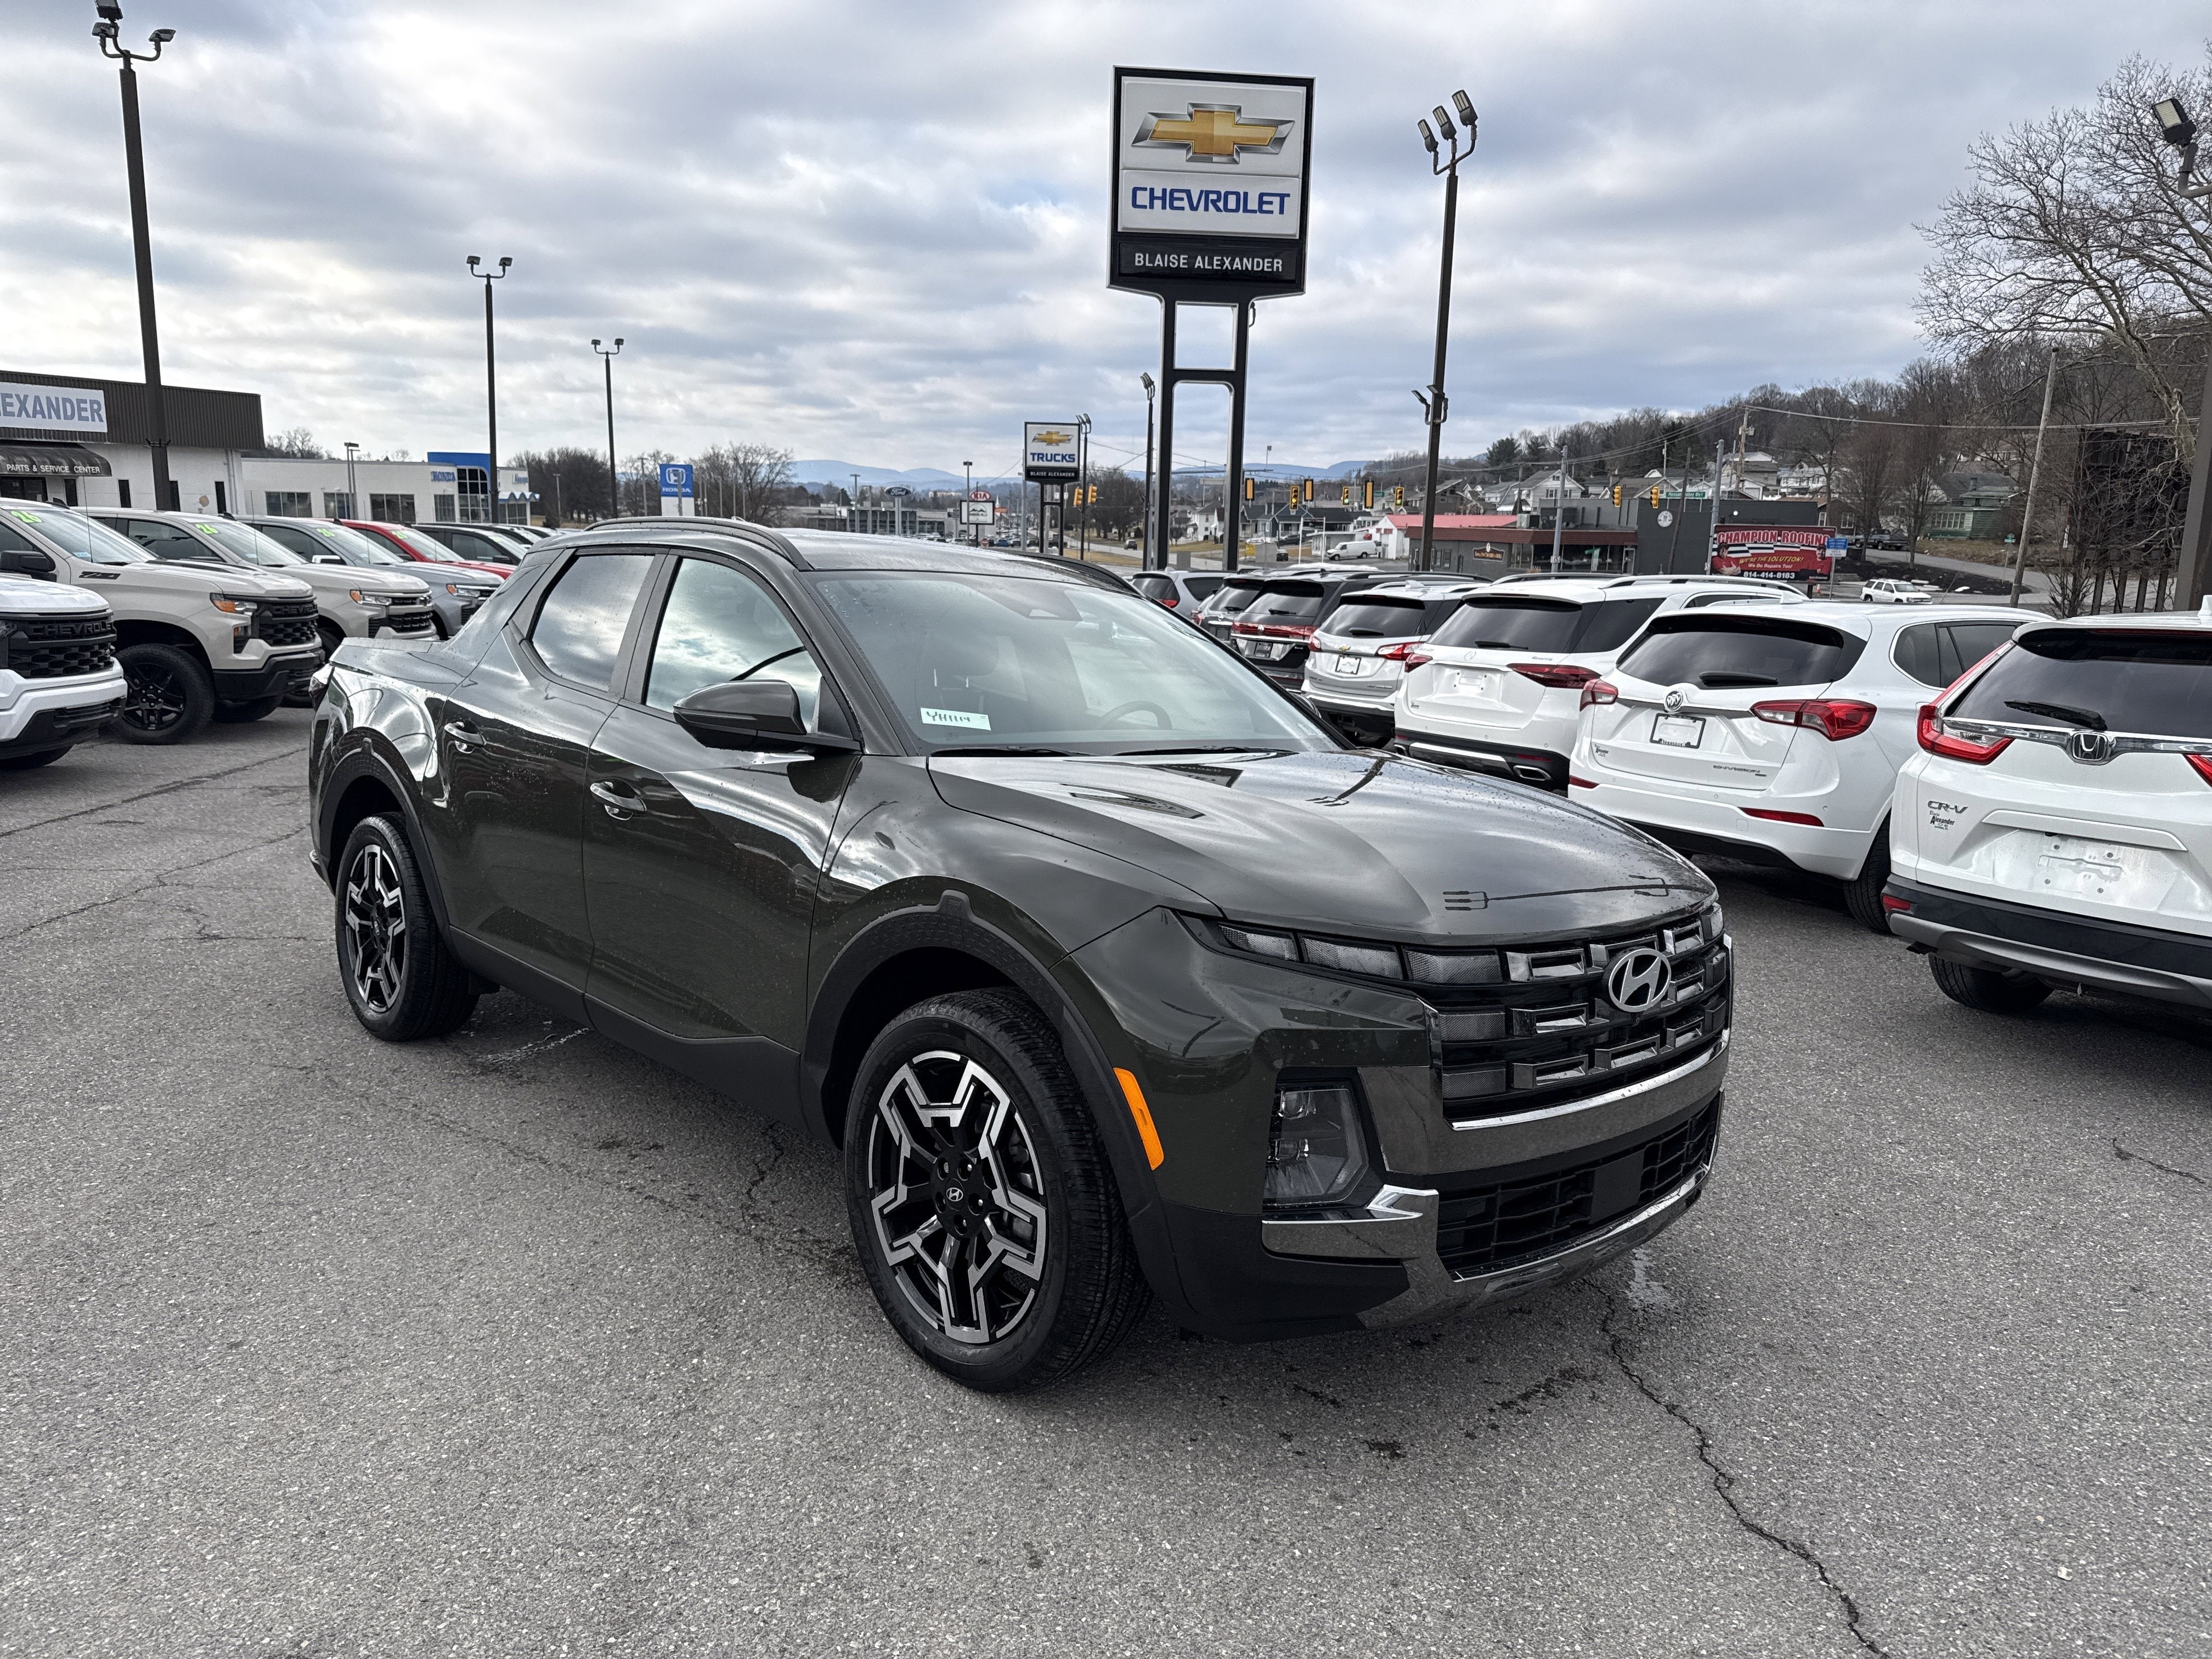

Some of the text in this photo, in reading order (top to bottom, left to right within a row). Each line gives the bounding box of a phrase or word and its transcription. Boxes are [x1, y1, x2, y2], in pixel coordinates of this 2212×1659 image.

[1131, 186, 1290, 215] CHEVROLET
[1134, 252, 1283, 272] BLAISE ALEXANDER
[0, 392, 104, 422] EXANDER
[1030, 452, 1075, 463] TRUCKS
[40, 465, 70, 473] SERVICE
[1717, 531, 1779, 545] CHAMPION
[1713, 765, 1760, 773] ENVISION
[1927, 800, 1968, 814] CR-V
[1930, 815, 1955, 826] Alexander
